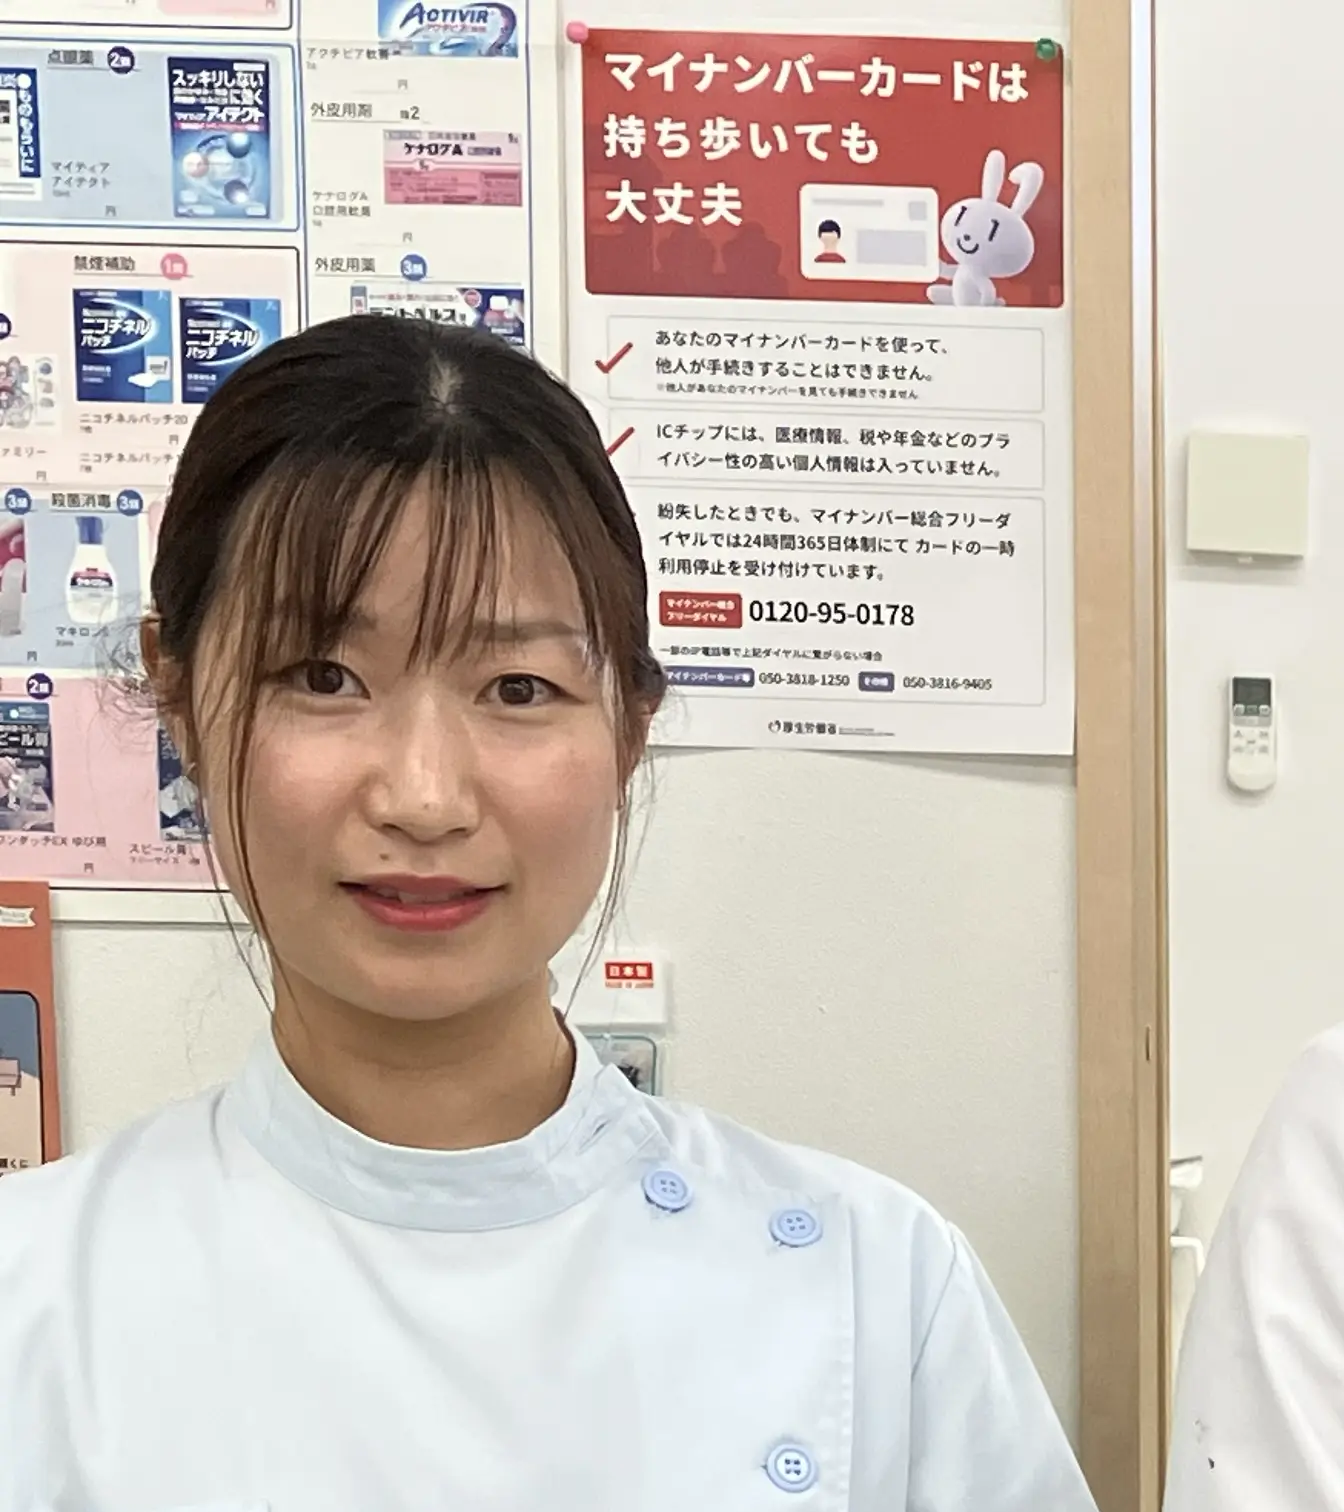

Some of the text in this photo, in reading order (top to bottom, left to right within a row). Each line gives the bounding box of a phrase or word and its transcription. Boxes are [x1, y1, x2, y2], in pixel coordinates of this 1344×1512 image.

[172, 69, 264, 88] スッキリしない
[603, 51, 1030, 103] マイナンバーカードは
[602, 113, 879, 165] 持ち歩いても
[604, 179, 744, 227] 大丈夫
[81, 318, 151, 336] ニコチネル
[186, 329, 259, 347] ニコチネル
[655, 329, 949, 355] あなたのマイナンバーカードを使って、
[654, 356, 934, 383] 他人が手続きすることはできません。
[656, 423, 1012, 450] ICチップには、医療情報、税や年金などのプラ
[656, 451, 1003, 478] イバシー性の高い個人情報は入っていません。
[656, 502, 1012, 530] 紛失したときでも、マイナンバー総合フリーダ
[658, 531, 1017, 559] イヤルでは24時間365日体制にて カードの一時
[657, 557, 886, 583] 利用停止を受け付けています。
[748, 599, 915, 627] 0120-95-0178
